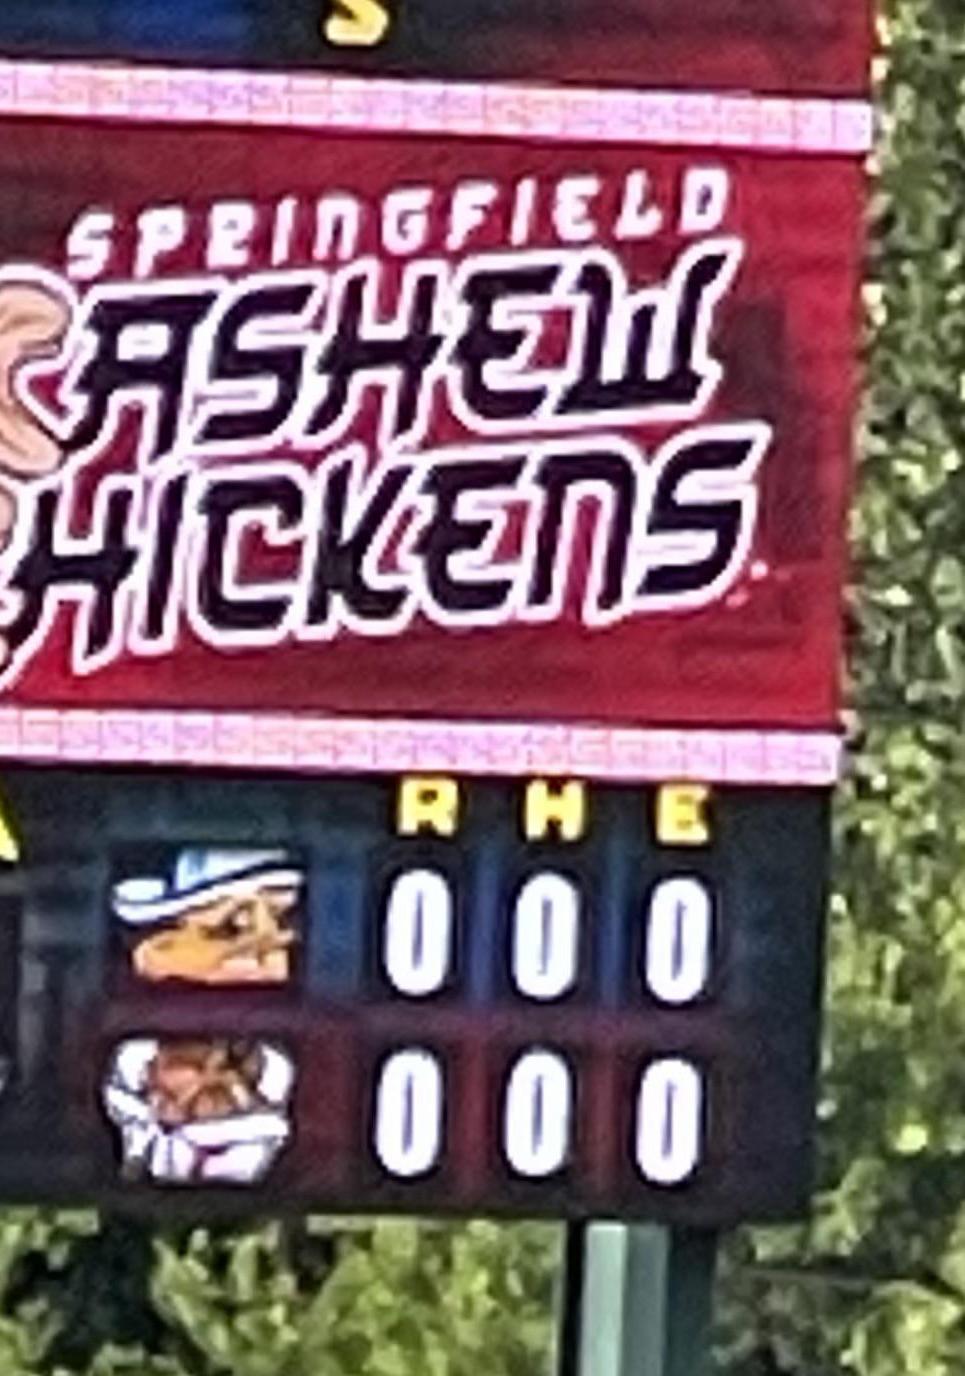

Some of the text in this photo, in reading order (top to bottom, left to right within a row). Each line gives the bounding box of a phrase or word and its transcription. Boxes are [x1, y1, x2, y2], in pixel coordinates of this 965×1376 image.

[66, 166, 731, 281] SPRINGFIELD
[397, 777, 711, 845] R H E
[384, 869, 711, 1004] 0 0 0
[375, 1049, 703, 1186] 0 0 0
